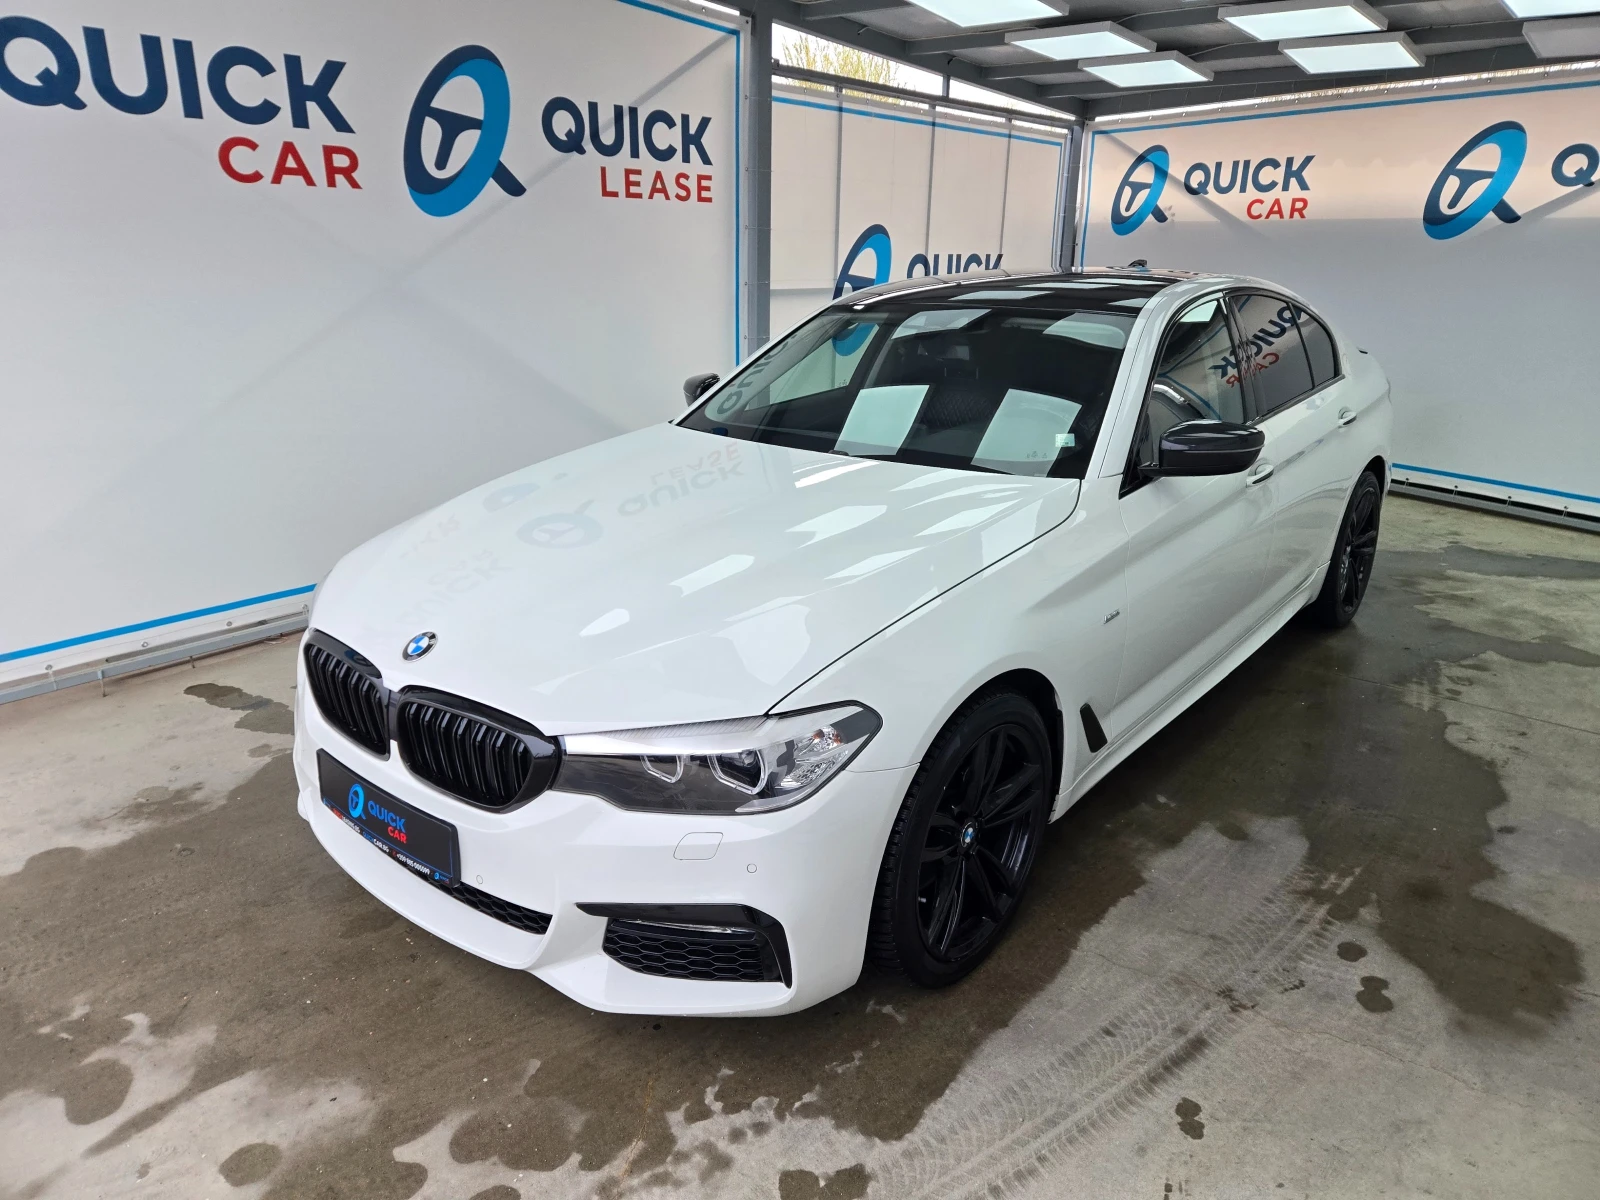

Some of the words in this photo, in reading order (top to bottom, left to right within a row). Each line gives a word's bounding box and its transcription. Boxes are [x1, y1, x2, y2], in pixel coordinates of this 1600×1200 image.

[0, 15, 356, 134] QUICK
[541, 96, 714, 166] QUICK
[218, 136, 363, 190] CAR
[1183, 154, 1317, 196] QUICK
[599, 165, 714, 204] LEASE
[1246, 197, 1309, 220] CAR
[367, 800, 406, 832] QUICK
[387, 826, 408, 844] CAR
